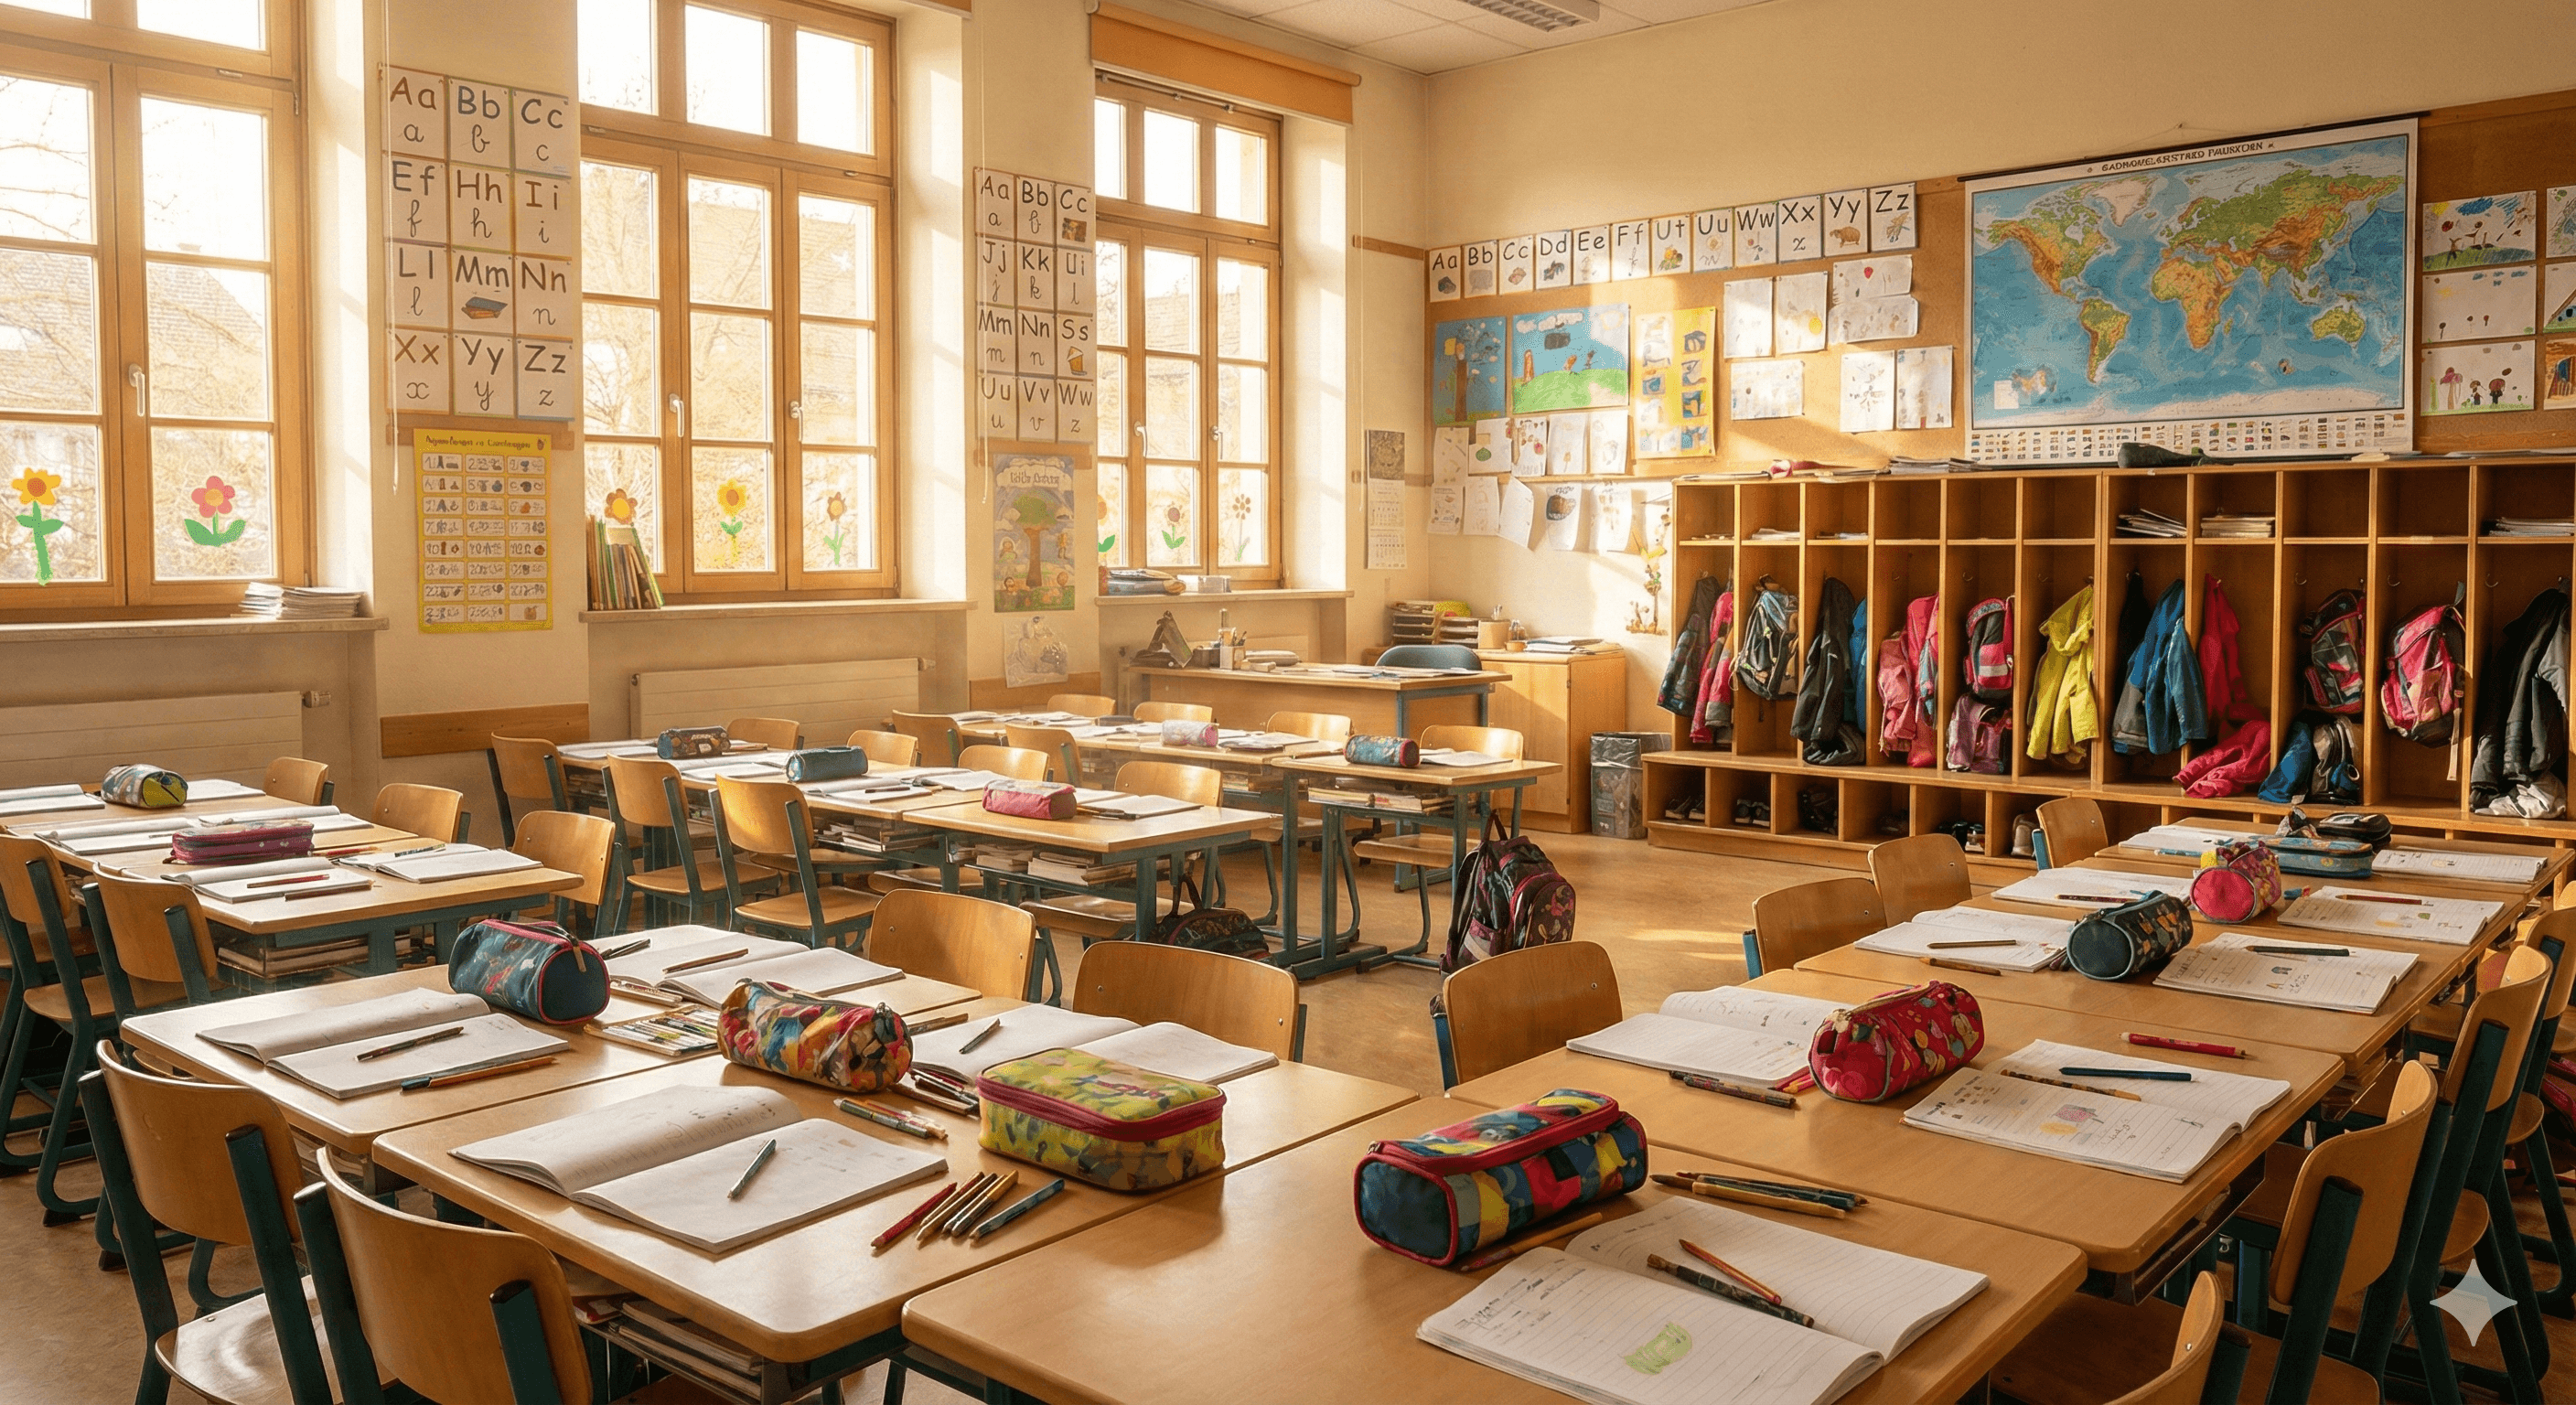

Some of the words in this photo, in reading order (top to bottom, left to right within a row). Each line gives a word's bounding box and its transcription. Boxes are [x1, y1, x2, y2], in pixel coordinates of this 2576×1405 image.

[391, 77, 436, 111] Aa
[457, 86, 501, 120] Bb
[521, 99, 564, 129] Cc
[403, 123, 424, 144] a
[536, 144, 549, 162] c
[392, 161, 435, 196] Ef
[457, 169, 502, 204] Hh
[981, 176, 1009, 199] Aa
[1022, 180, 1048, 207] Bb
[1060, 189, 1087, 212] Cc
[539, 220, 550, 243] i
[988, 212, 1002, 226] a
[1433, 252, 1457, 271] Aa
[1468, 247, 1493, 265] Bb
[1503, 242, 1529, 261] Cc
[1540, 233, 1567, 255] Dd
[1578, 231, 1605, 251] Ee
[1617, 223, 1643, 246] Ff
[1698, 214, 1728, 235] Uu
[1737, 208, 1775, 231] Ww
[1782, 202, 1815, 225] Xx
[1829, 195, 1861, 223] Yy
[1875, 189, 1909, 212] Zz
[982, 241, 1006, 273] Jj
[1023, 246, 1049, 273] Kk
[455, 254, 510, 288] Mm
[521, 262, 566, 293] Nn
[532, 306, 556, 326] n
[979, 309, 1012, 335] Mm
[1022, 314, 1049, 338] Nn
[1062, 319, 1088, 340] Ss
[394, 334, 440, 365] Xx
[462, 338, 504, 375] Yy
[524, 345, 566, 373] Zz
[986, 347, 1005, 362] m
[1030, 351, 1044, 366] n
[474, 380, 494, 411] y
[539, 388, 554, 406] z
[982, 377, 1010, 401] Uu
[1024, 381, 1049, 402] Vv
[1058, 383, 1092, 406] Ww
